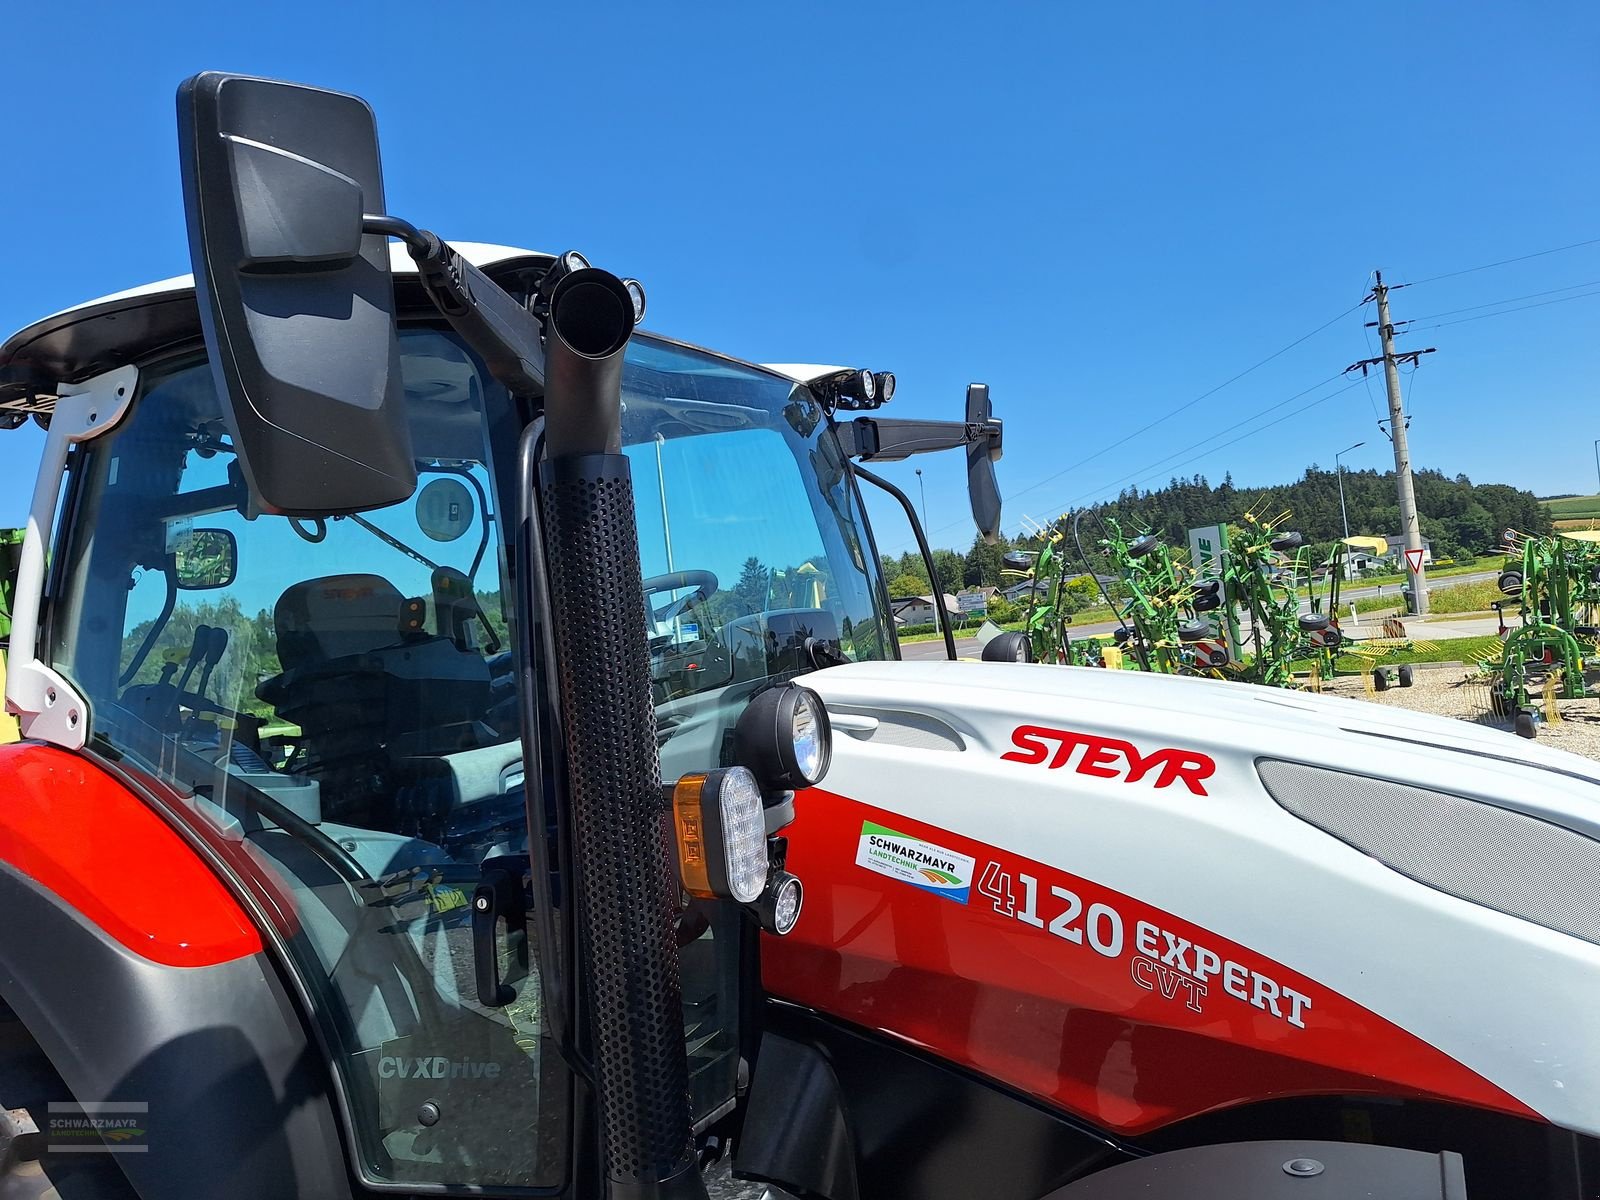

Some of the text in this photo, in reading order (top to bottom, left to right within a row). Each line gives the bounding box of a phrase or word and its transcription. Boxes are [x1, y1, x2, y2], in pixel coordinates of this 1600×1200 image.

[1000, 725, 1216, 796] STEYR
[868, 847, 918, 871] LANDTECHNIK
[869, 835, 956, 874] SCHWARZMAYR
[977, 861, 1313, 1030] 4120 EXPERT
[1130, 955, 1208, 1014] CVT
